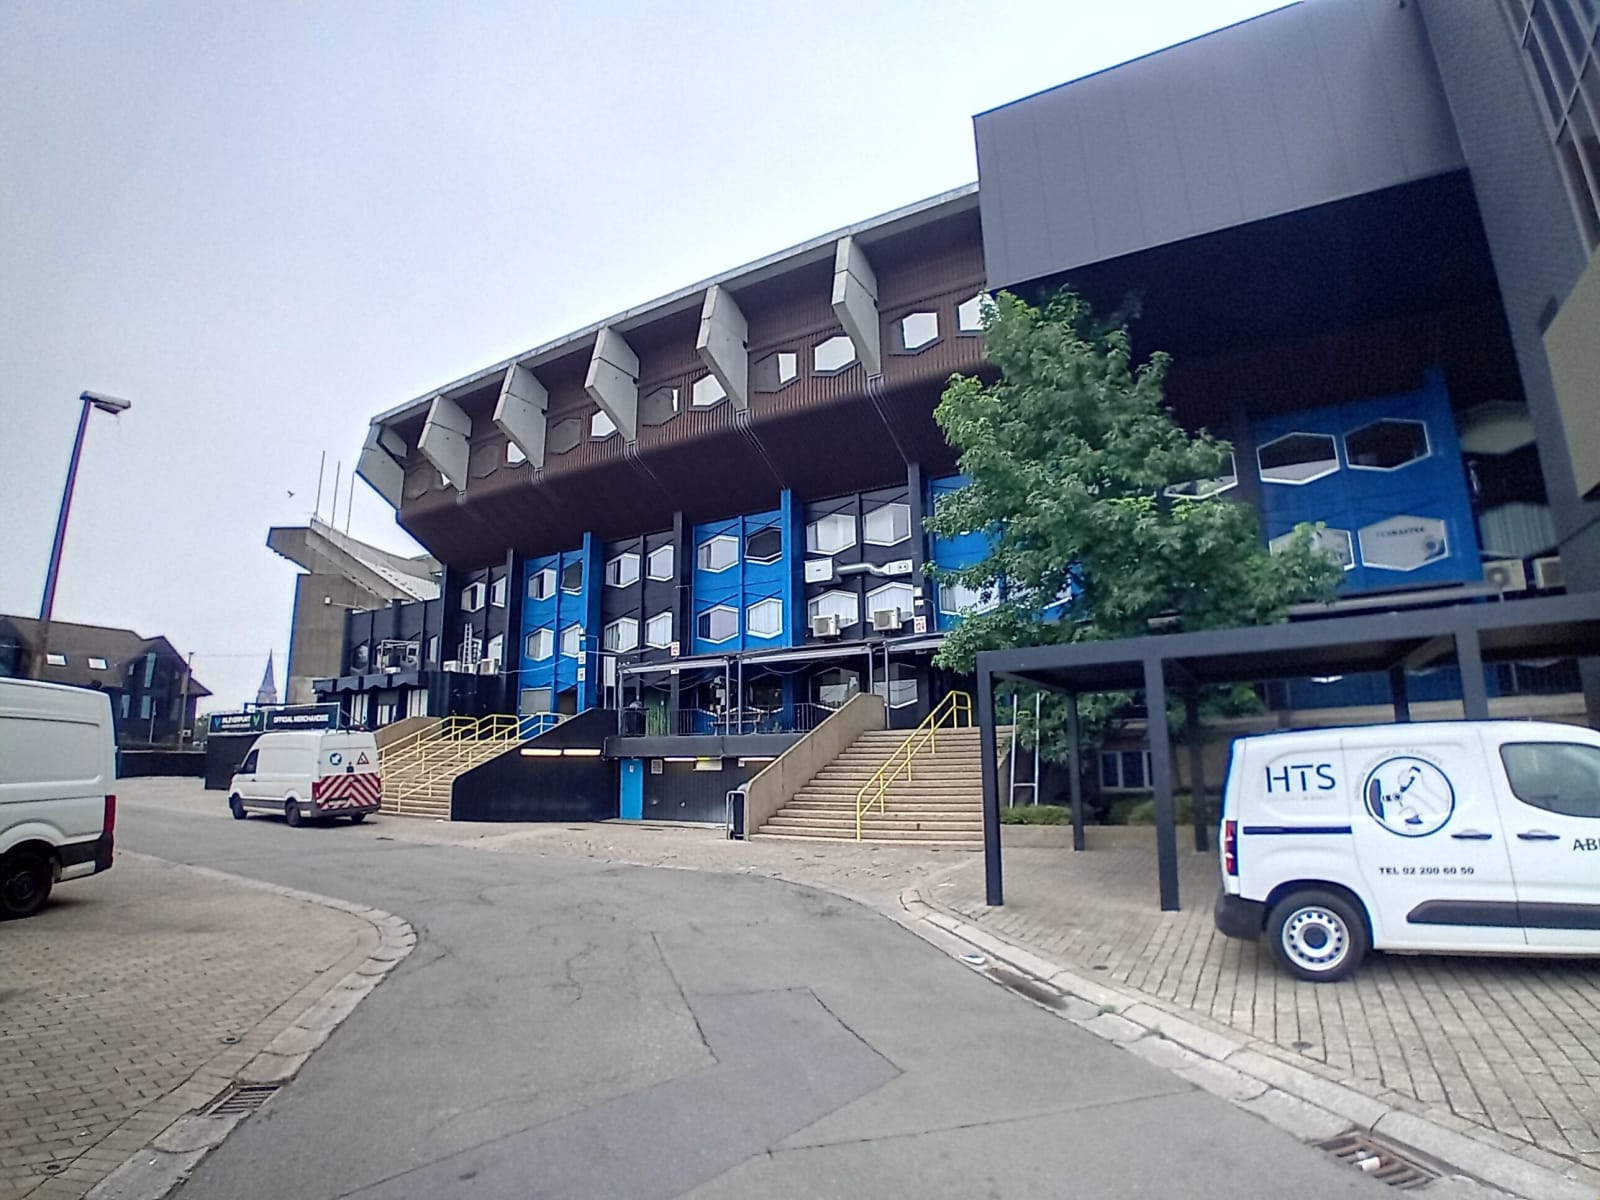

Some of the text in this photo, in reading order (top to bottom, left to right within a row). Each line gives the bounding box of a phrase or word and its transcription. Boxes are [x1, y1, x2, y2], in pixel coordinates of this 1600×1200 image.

[273, 714, 329, 724] OFFICIAL MERCHANDISE
[1265, 763, 1337, 793] HTS
[1573, 837, 1600, 852] AB
[1379, 866, 1399, 876] TEL
[1402, 866, 1416, 876] 02
[1419, 866, 1440, 876] 200
[1460, 866, 1475, 876] 50
